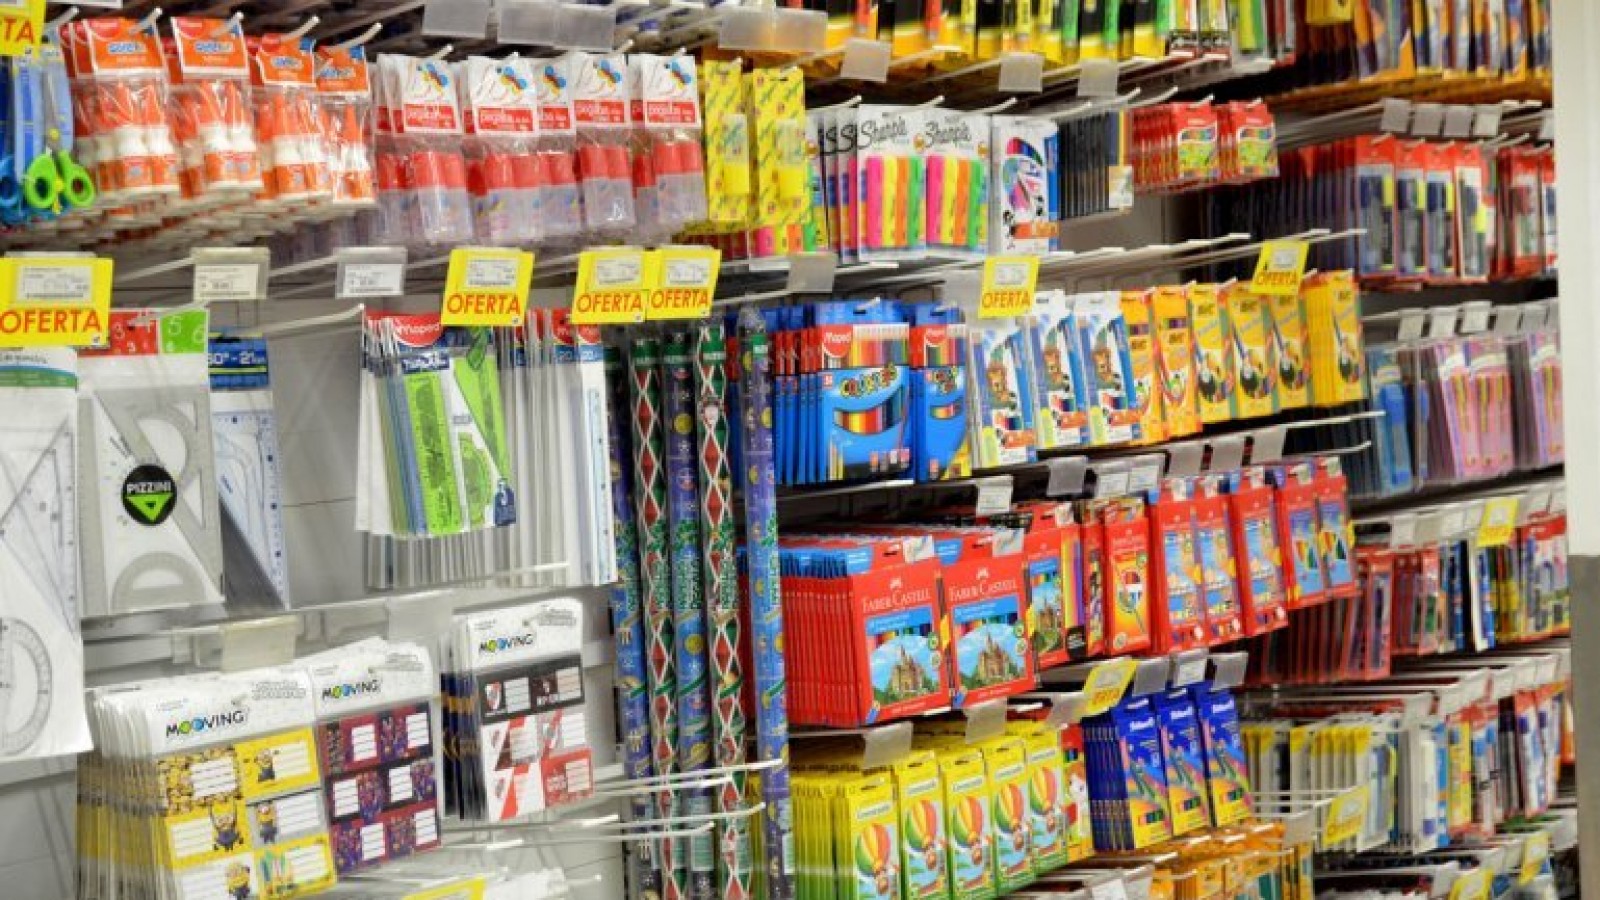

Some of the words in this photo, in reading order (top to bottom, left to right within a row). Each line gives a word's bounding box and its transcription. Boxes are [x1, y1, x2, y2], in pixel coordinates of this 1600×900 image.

[447, 293, 521, 315] OFERTA
[577, 294, 642, 313] OFERTA
[651, 288, 709, 309] OFERTA
[982, 291, 1031, 309] OFERTA
[0, 308, 102, 334] OFERTA
[479, 633, 534, 653] MOOVING
[322, 680, 379, 700] MOOVING
[165, 710, 245, 738] MOOVING
